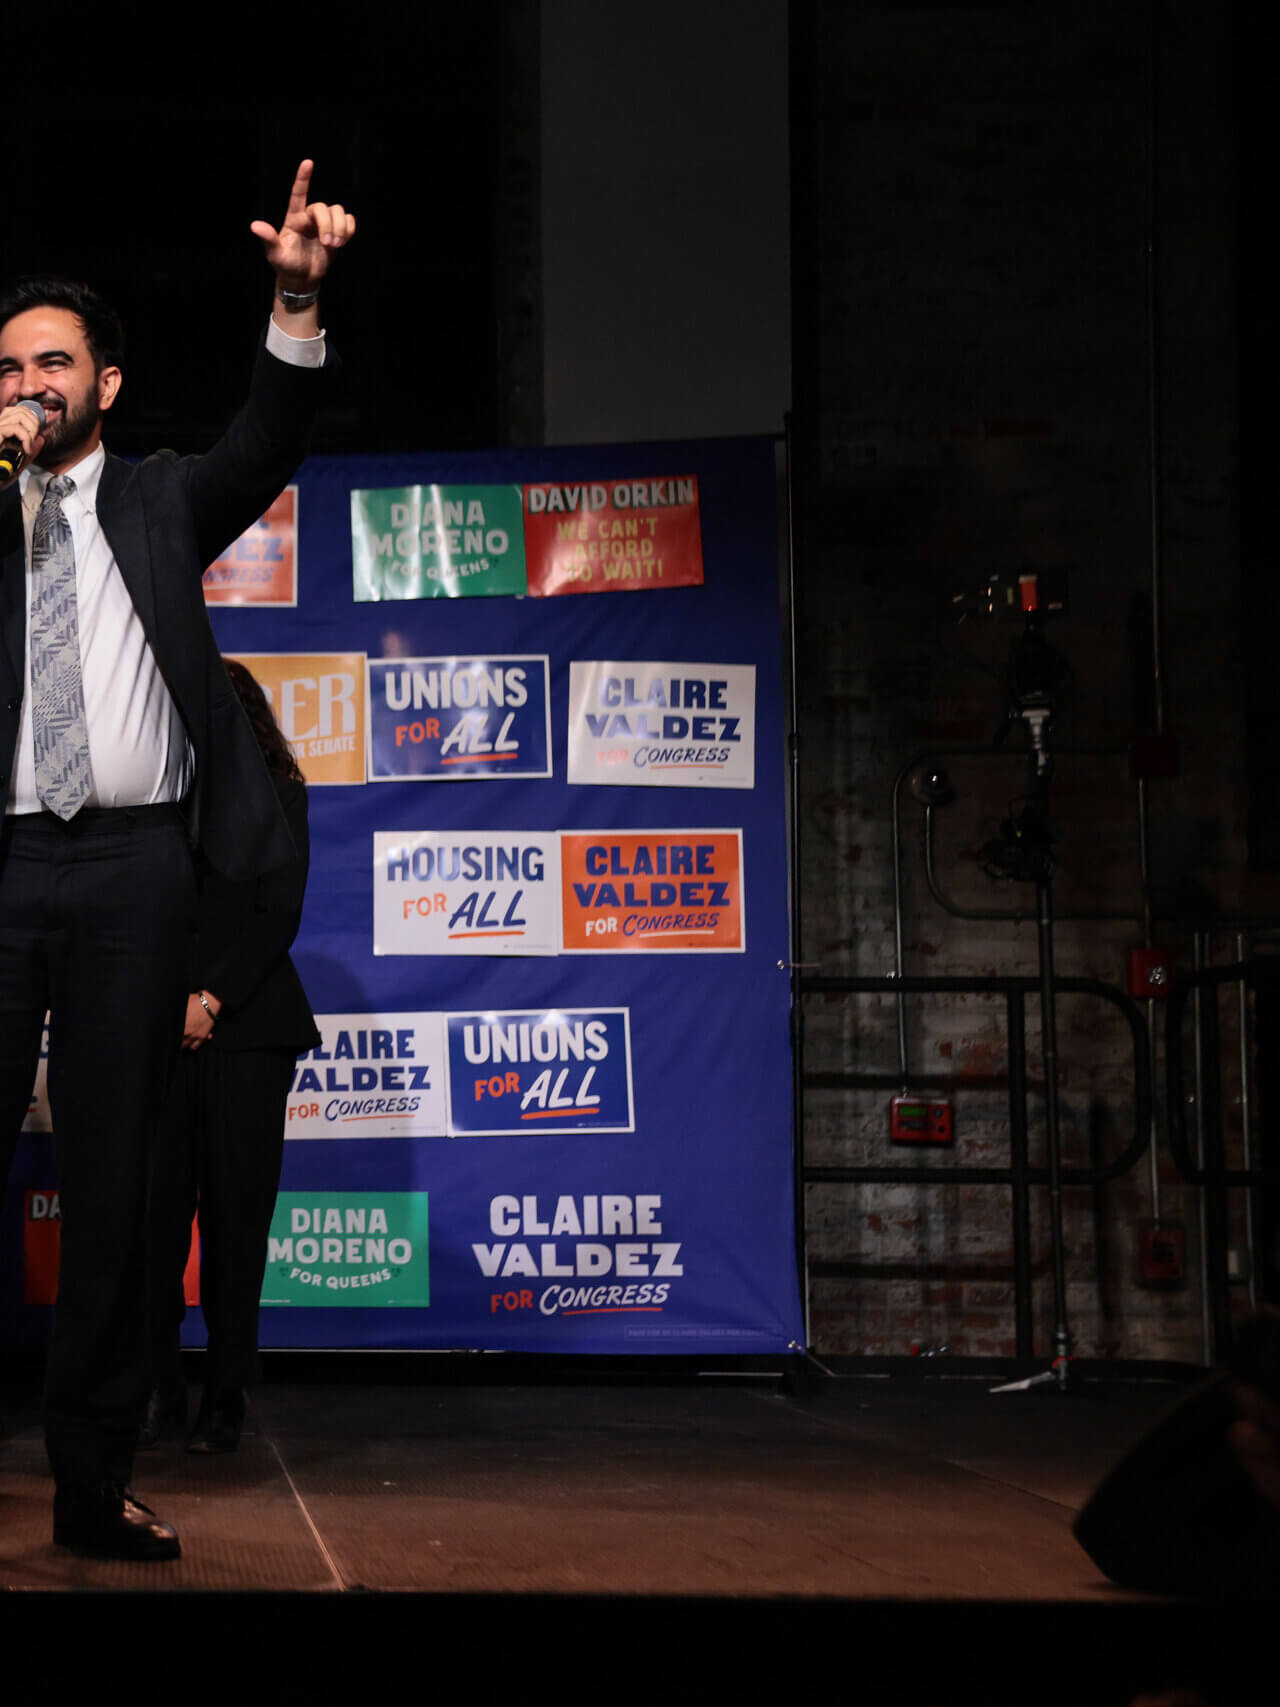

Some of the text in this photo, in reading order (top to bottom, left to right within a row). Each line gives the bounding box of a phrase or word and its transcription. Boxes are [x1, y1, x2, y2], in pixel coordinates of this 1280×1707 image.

[529, 479, 694, 513] DAVID ORKIN
[390, 500, 486, 528] DIANA
[558, 516, 658, 541] WE CAN'T
[371, 529, 509, 560] MORENO
[574, 538, 654, 562] AFFORD
[203, 566, 275, 584] NGRESS
[568, 559, 664, 583] TO WAIT!
[385, 667, 528, 711] UNIONS
[600, 678, 728, 710] CLAIRE
[261, 672, 356, 741] ER
[395, 712, 520, 756] FOR ALL
[585, 714, 741, 742] VALDEZ
[633, 746, 732, 768] CONGRESS
[387, 846, 545, 882] HOUSING
[585, 845, 715, 876] CLAIRE
[403, 890, 526, 929] FOR ALL
[572, 882, 730, 908] VALDEZ
[585, 913, 720, 936] FOR CONGRESS
[464, 1020, 609, 1064] UNIONS
[474, 1066, 601, 1110] FOR ALL
[288, 1097, 421, 1122] FOR CONGRESS
[291, 1208, 388, 1234] DIANA
[490, 1194, 662, 1236] CLAIRE
[268, 1237, 413, 1264] MORENO
[472, 1242, 684, 1277] VALDEZ
[289, 1267, 392, 1290] FOR QUEENS
[490, 1283, 671, 1315] FOR CONGRESS
